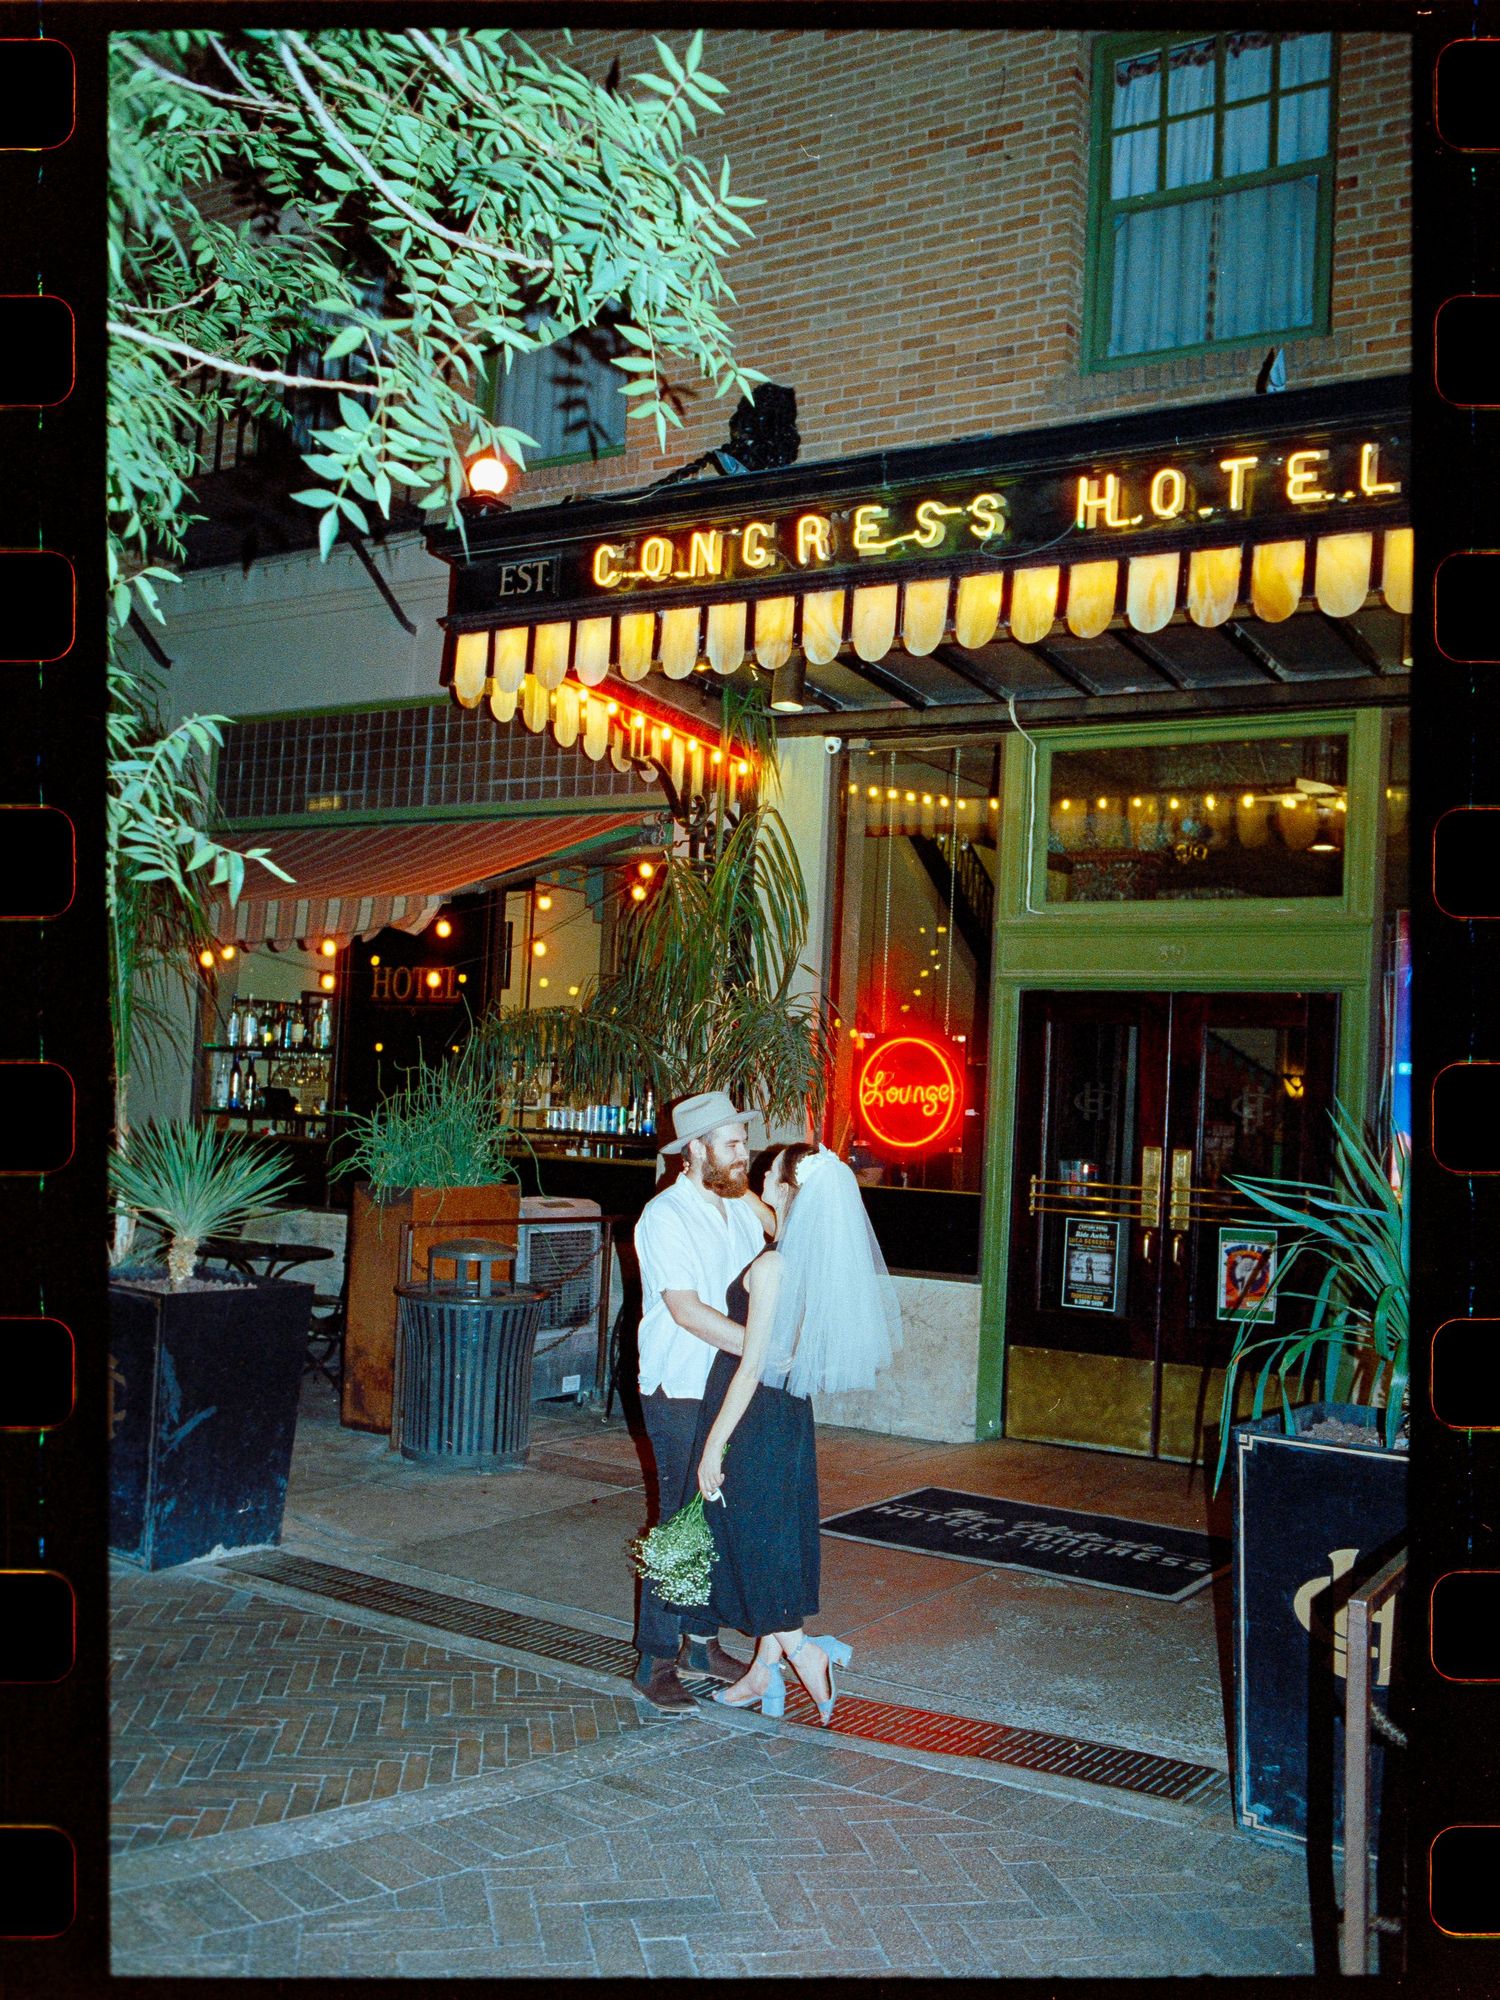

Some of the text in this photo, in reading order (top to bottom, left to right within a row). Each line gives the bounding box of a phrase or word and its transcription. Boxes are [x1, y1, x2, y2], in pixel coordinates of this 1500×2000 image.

[593, 442, 1401, 589] CONGRESS HOTEL
[371, 966, 461, 999] HOTEL
[862, 1070, 950, 1116] Lounge
[873, 1505, 1212, 1572] HOTEL CONGRESS
